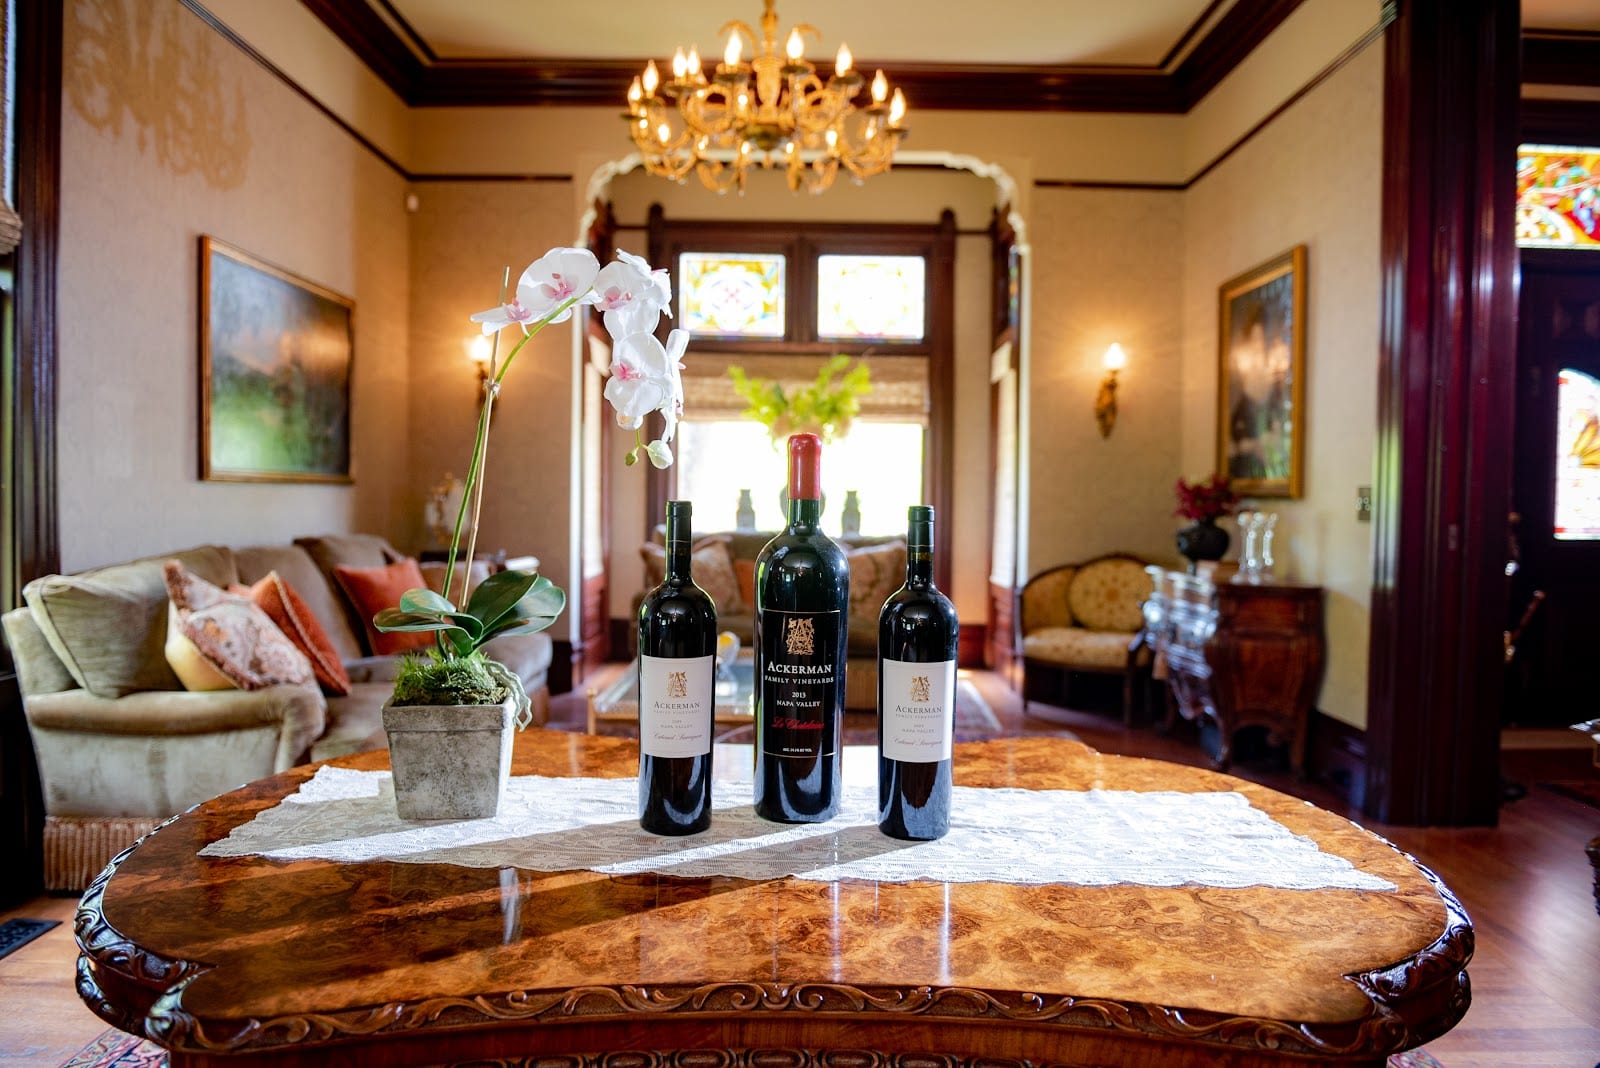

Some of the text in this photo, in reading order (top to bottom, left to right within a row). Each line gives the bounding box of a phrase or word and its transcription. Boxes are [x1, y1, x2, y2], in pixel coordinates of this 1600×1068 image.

[768, 660, 832, 674] ACKERMAN
[764, 676, 834, 685] FAMILY VINEYARDS
[654, 701, 700, 710] ACKERMAN
[896, 705, 942, 714] ACKERMAN
